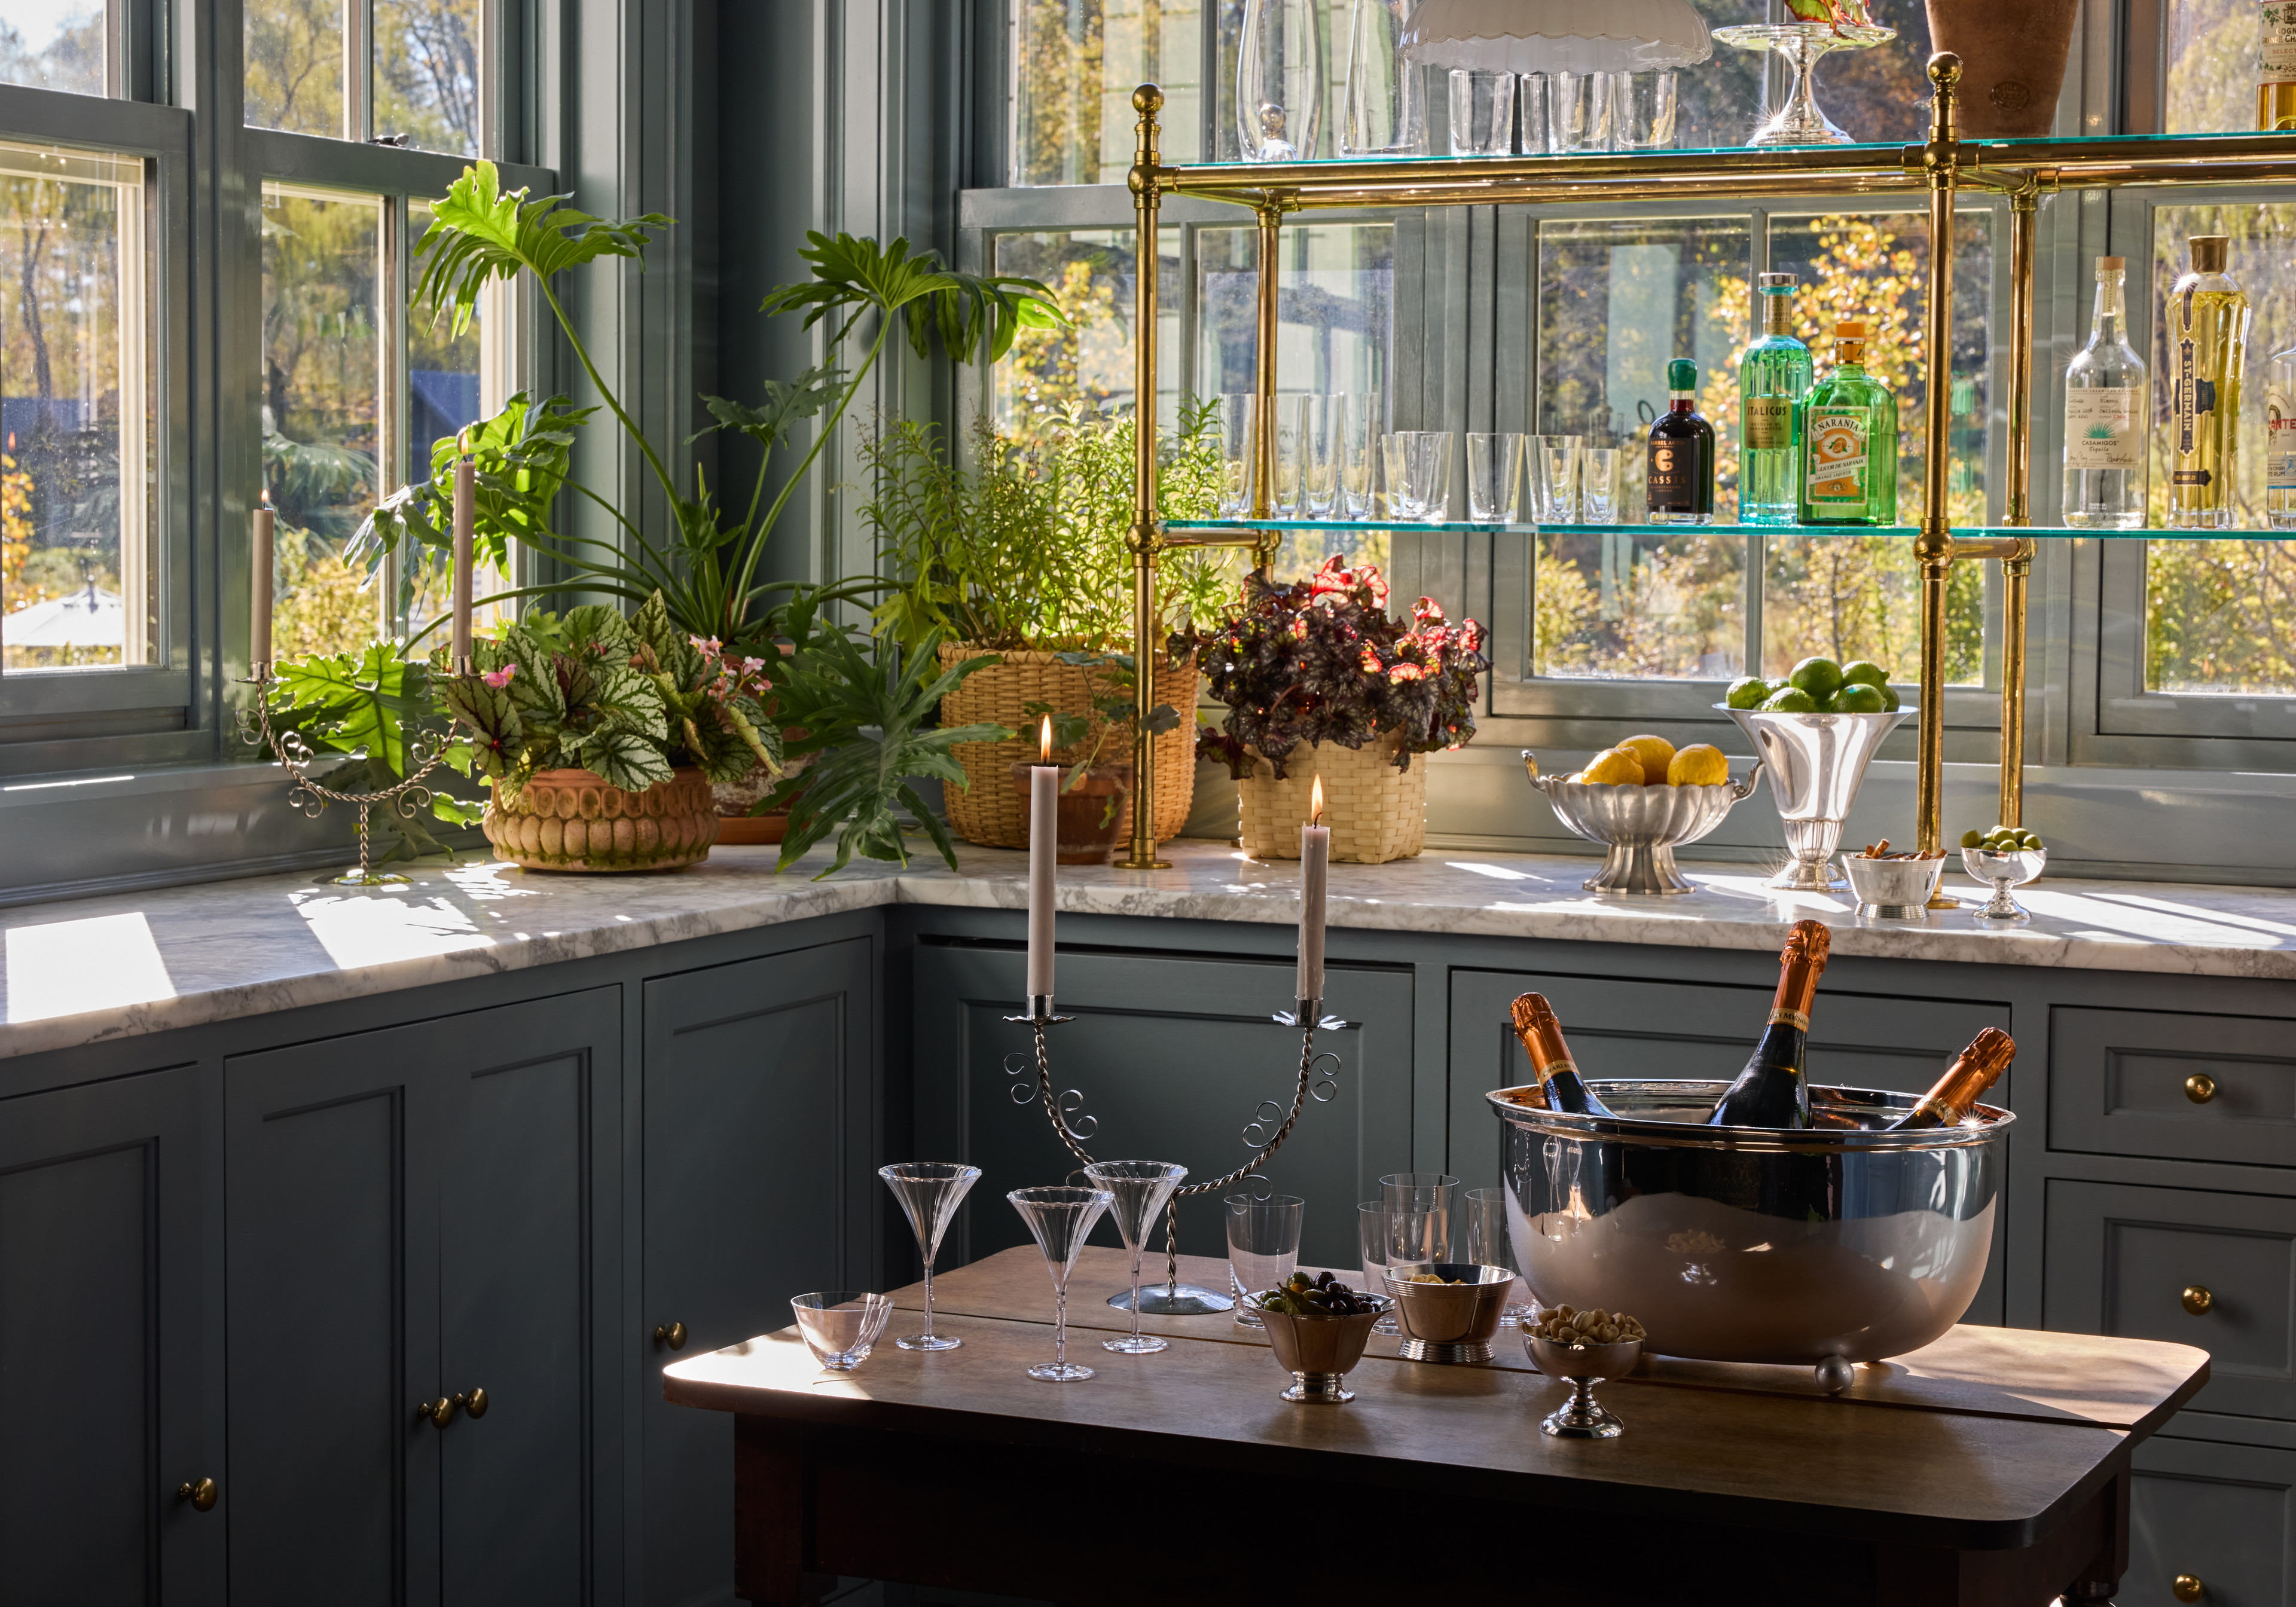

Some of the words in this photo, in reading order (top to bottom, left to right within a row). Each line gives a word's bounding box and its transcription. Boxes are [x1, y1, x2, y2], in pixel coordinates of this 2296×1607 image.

[2184, 360, 2193, 431] ST-GERMAIN
[1748, 407, 1787, 416] ITALICUS
[1818, 418, 1859, 432] NARANJA
[1819, 463, 1835, 472] LICOR
[1842, 459, 1863, 467] NARANJA
[1543, 1064, 1571, 1077] CHARLES
